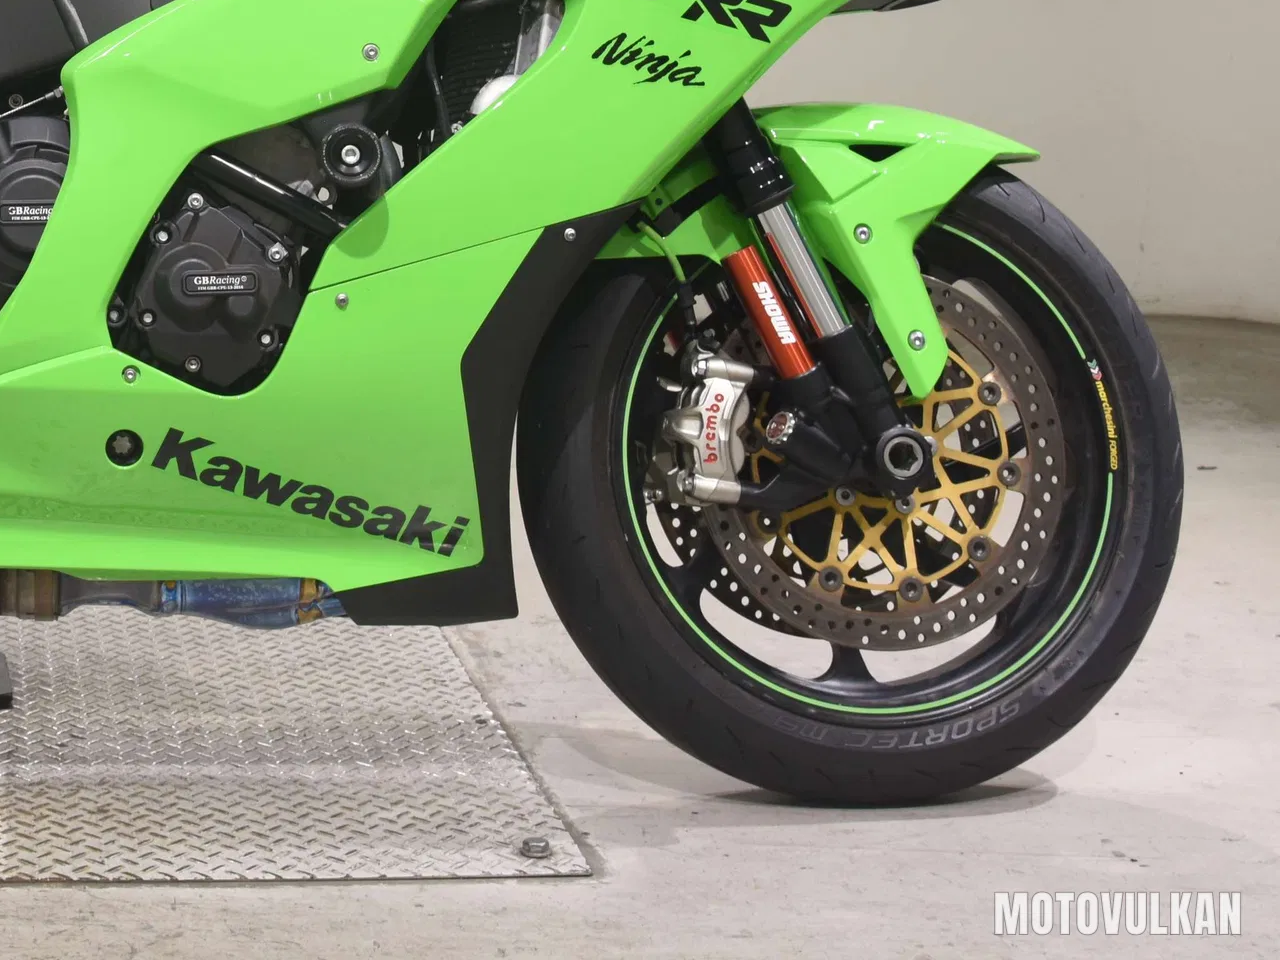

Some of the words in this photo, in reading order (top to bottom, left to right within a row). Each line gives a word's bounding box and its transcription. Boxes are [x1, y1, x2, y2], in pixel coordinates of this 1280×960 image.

[591, 32, 705, 87] Ninja
[752, 281, 796, 345] SHOWA
[704, 393, 724, 464] brembo
[1095, 380, 1118, 438] marchesini
[1109, 439, 1118, 470] FORGED
[151, 427, 470, 558] Kawasaki
[844, 691, 1023, 750] SPORTEC
